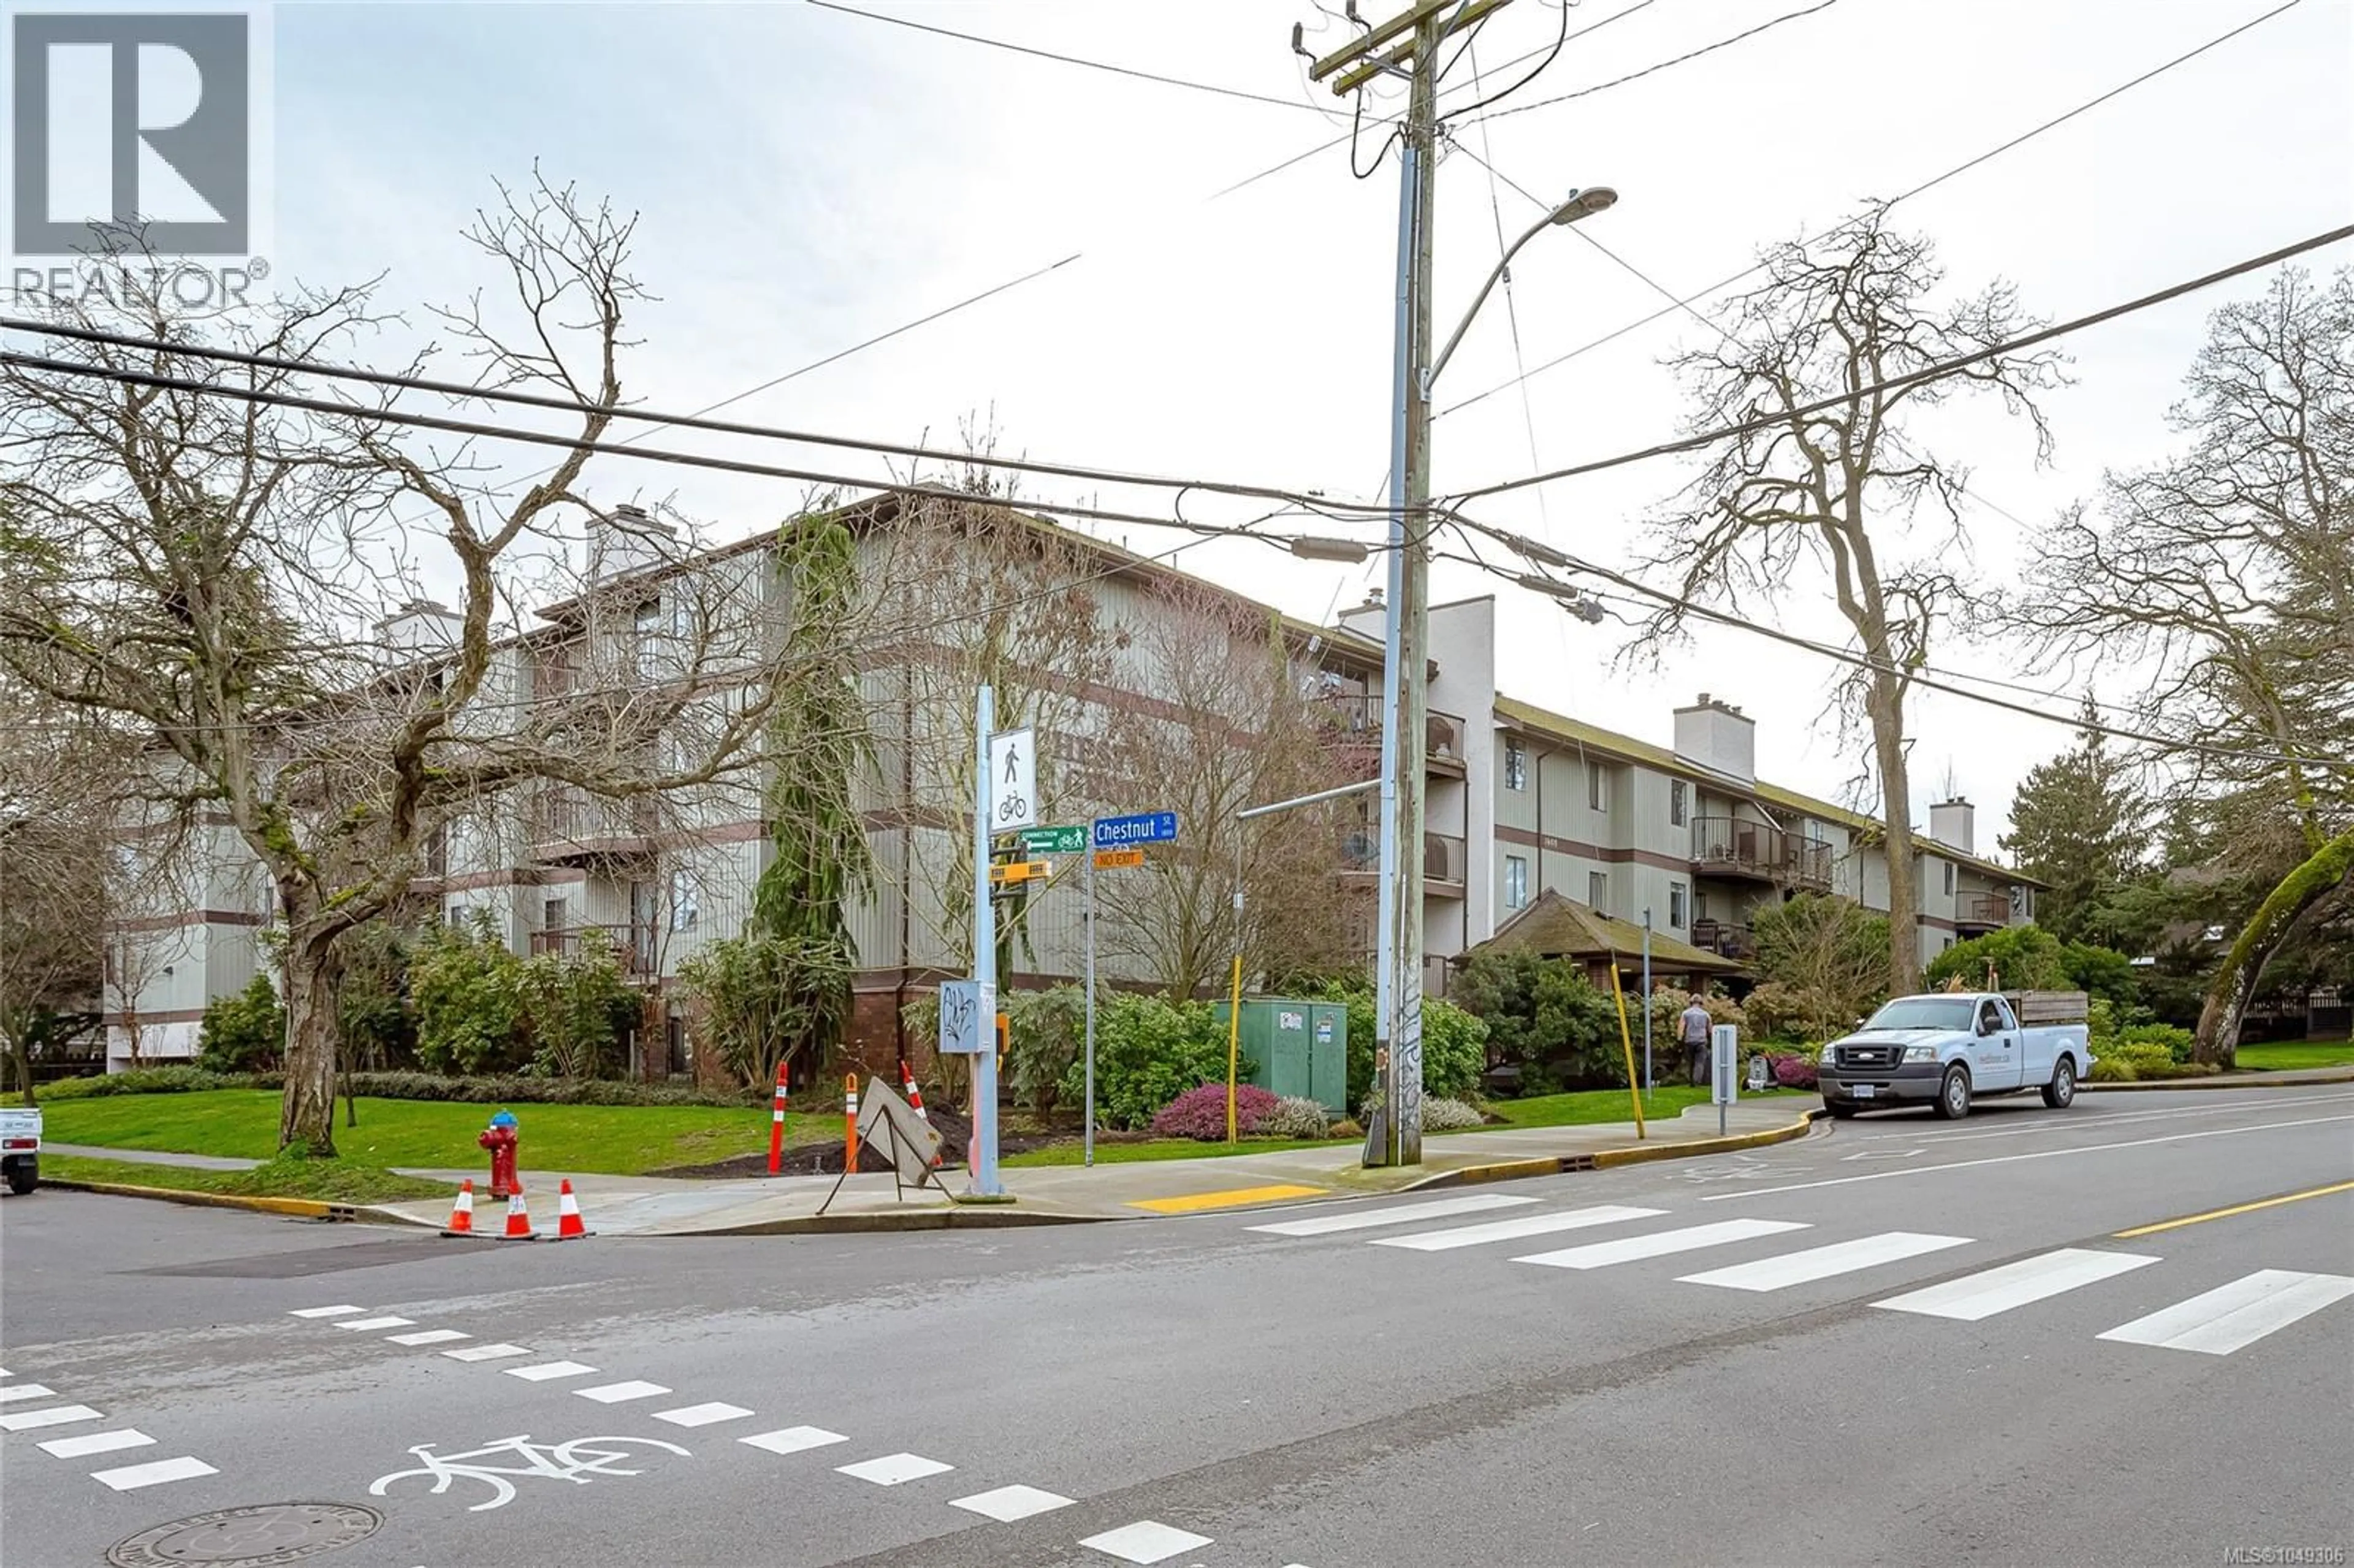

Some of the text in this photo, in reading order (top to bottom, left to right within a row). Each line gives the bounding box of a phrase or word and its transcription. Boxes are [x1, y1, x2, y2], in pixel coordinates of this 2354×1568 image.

[1096, 818, 1155, 841] Chestnut
[1098, 852, 1135, 866] NO EXIT
